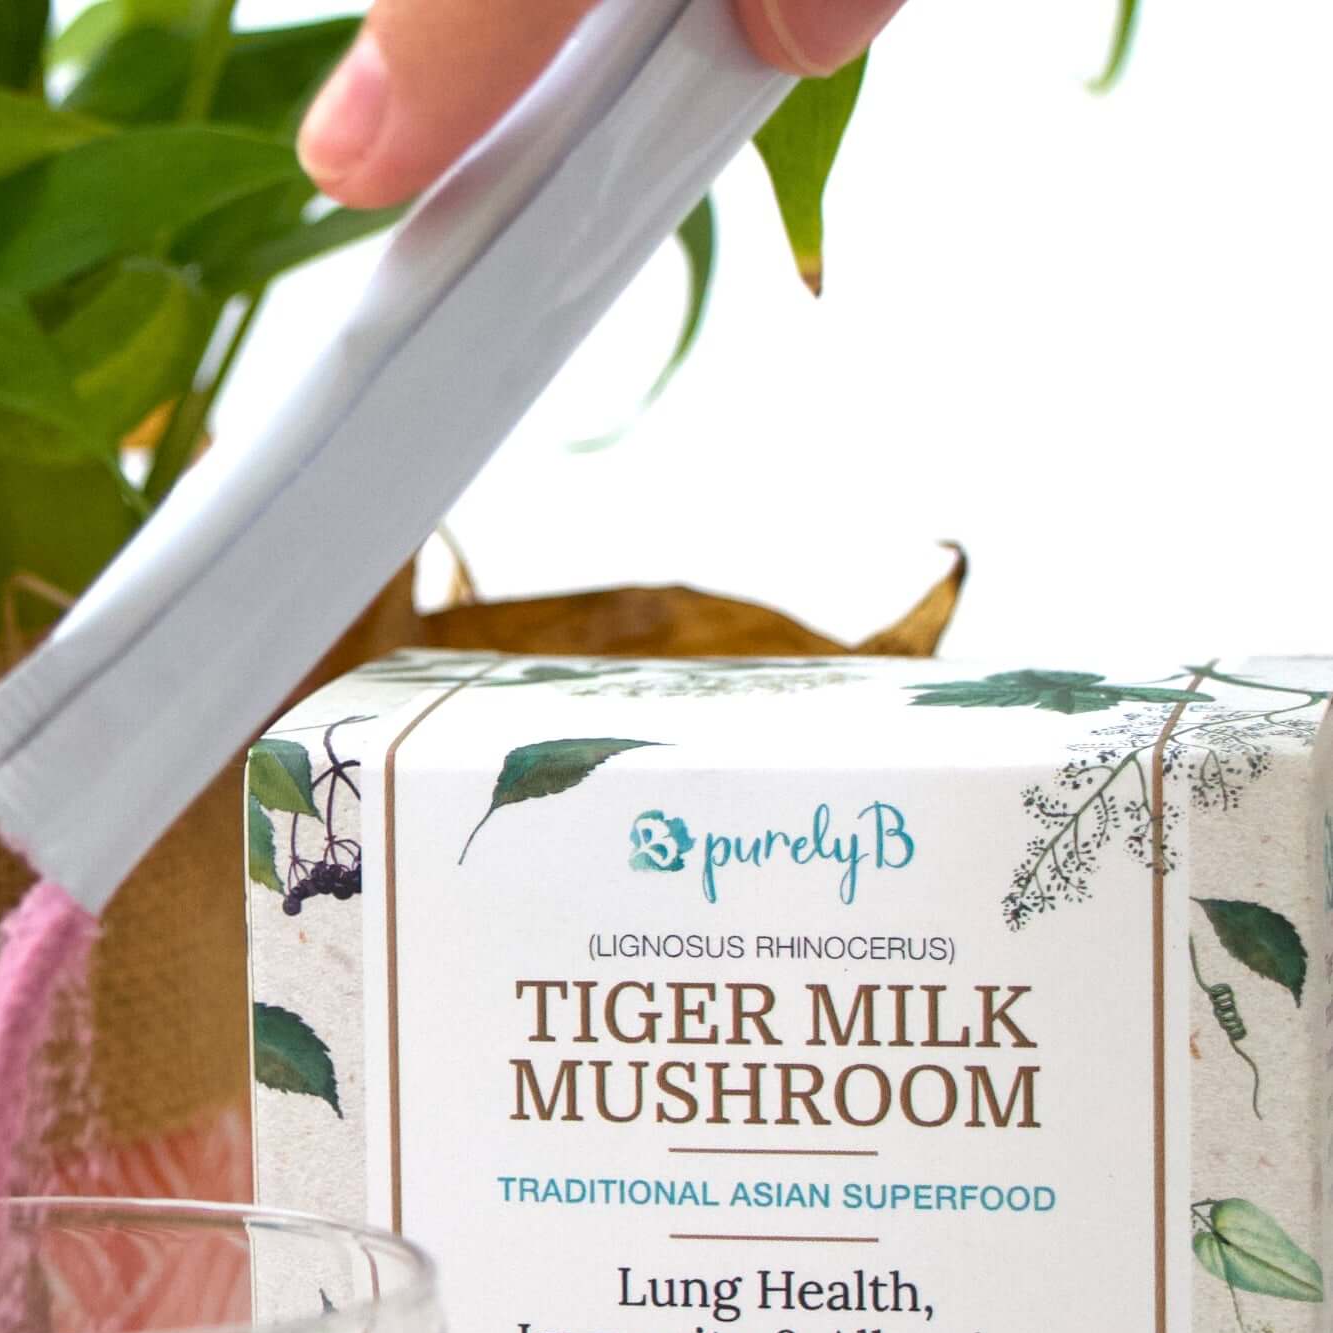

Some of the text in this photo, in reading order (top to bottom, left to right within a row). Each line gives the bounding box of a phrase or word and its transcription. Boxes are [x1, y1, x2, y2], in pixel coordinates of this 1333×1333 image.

[588, 933, 956, 966] (LIGNOSUS RHINOCERUS)
[515, 979, 1039, 1049] TIGER MILK
[508, 1058, 1042, 1129] MUSHROOM
[497, 1176, 1057, 1212] TRADITIONAL ASIAN SUPERFOOD
[617, 1267, 935, 1323] Lung Health,
